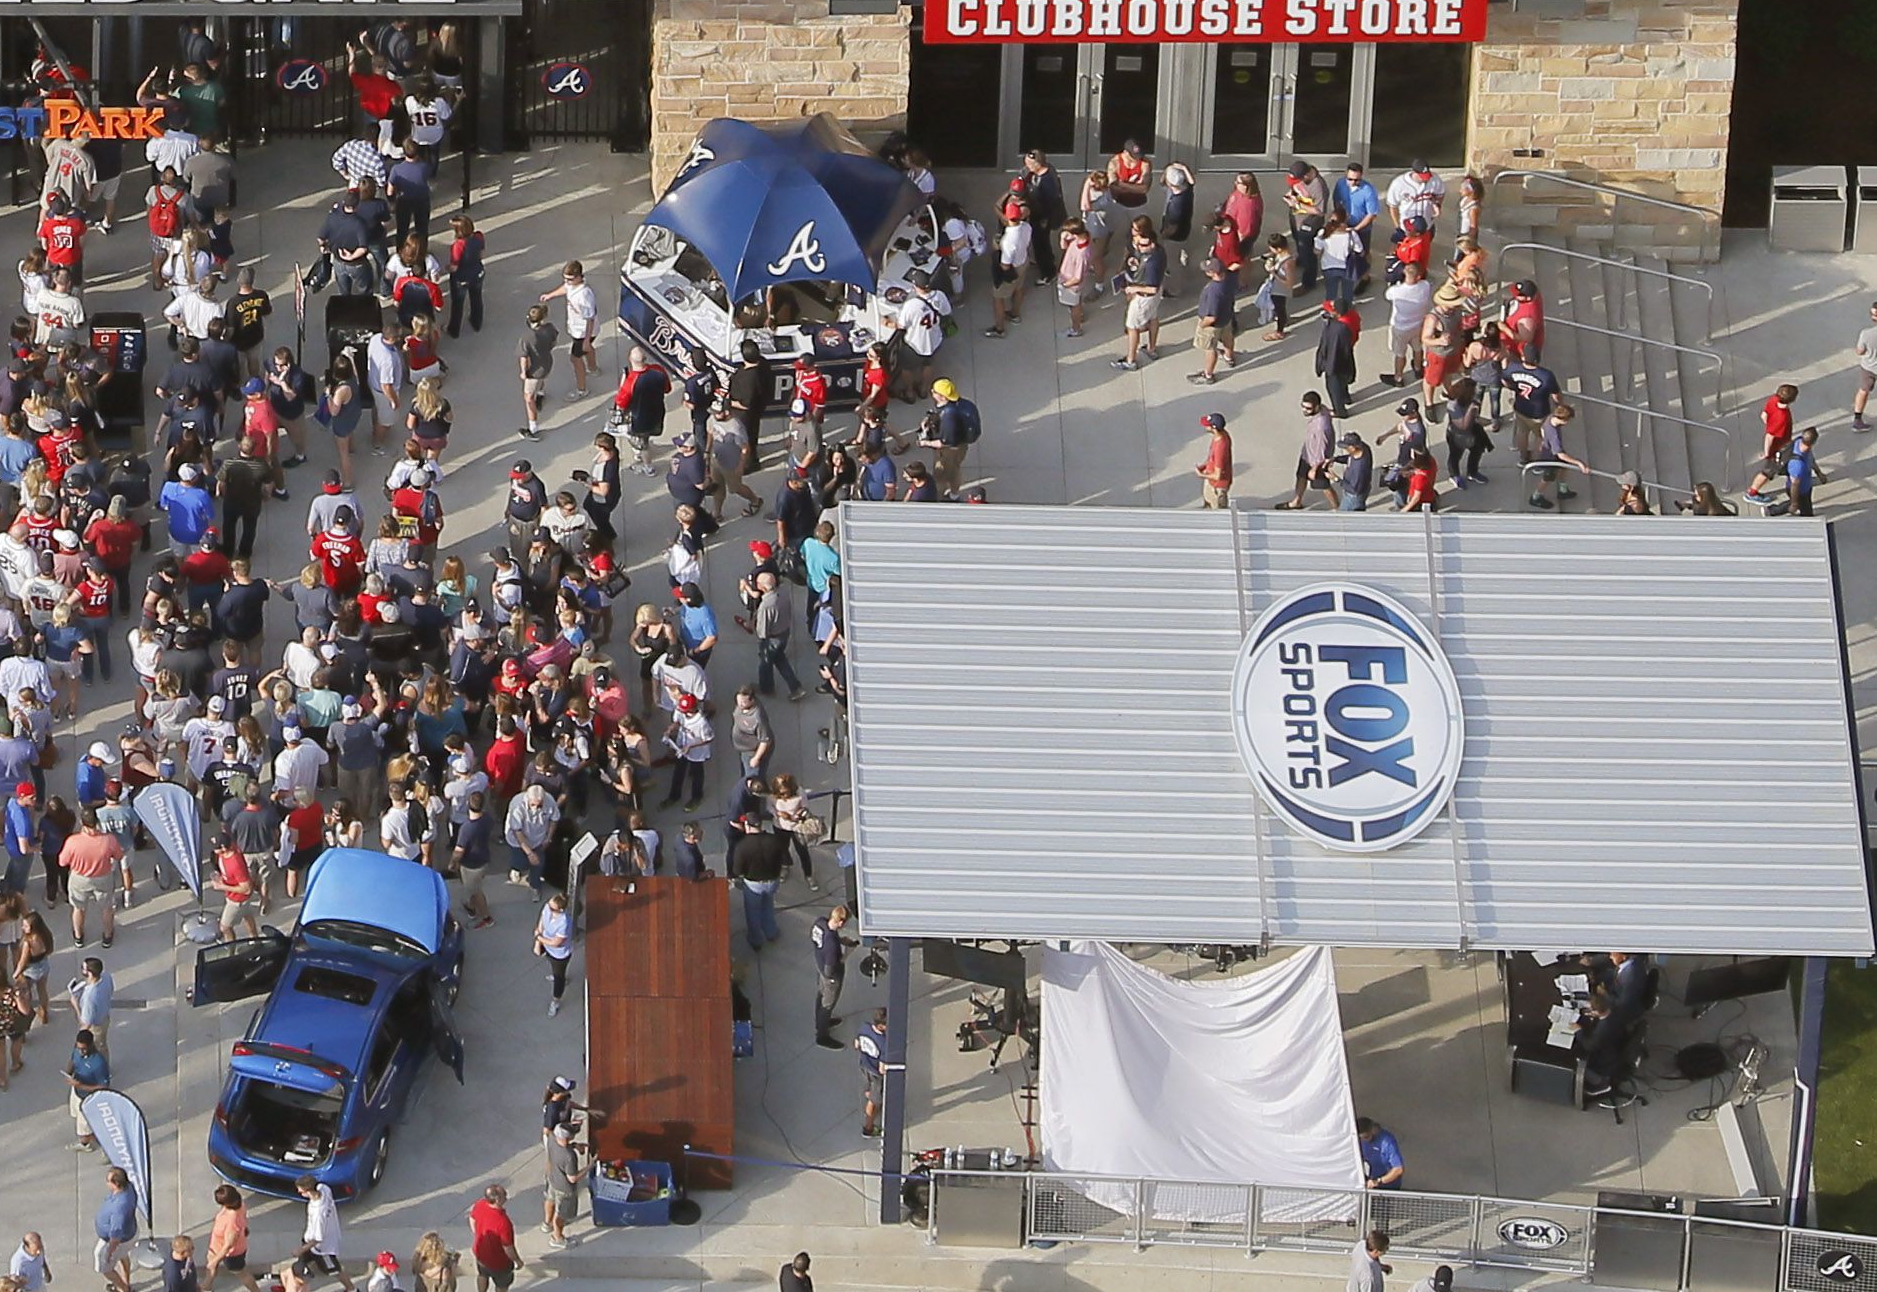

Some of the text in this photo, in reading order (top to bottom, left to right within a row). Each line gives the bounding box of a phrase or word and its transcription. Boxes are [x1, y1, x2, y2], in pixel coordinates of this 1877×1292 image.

[413, 111, 437, 126] 16
[54, 234, 73, 249] 10
[243, 309, 258, 327] 21
[0, 554, 19, 575] 25
[329, 549, 342, 568] 5
[89, 594, 108, 606] 10
[227, 683, 248, 700] 10
[1278, 642, 1323, 789] SPORTS
[1317, 644, 1417, 789] FOX
[203, 737, 217, 754] 7
[1513, 1223, 1550, 1238] FOX
